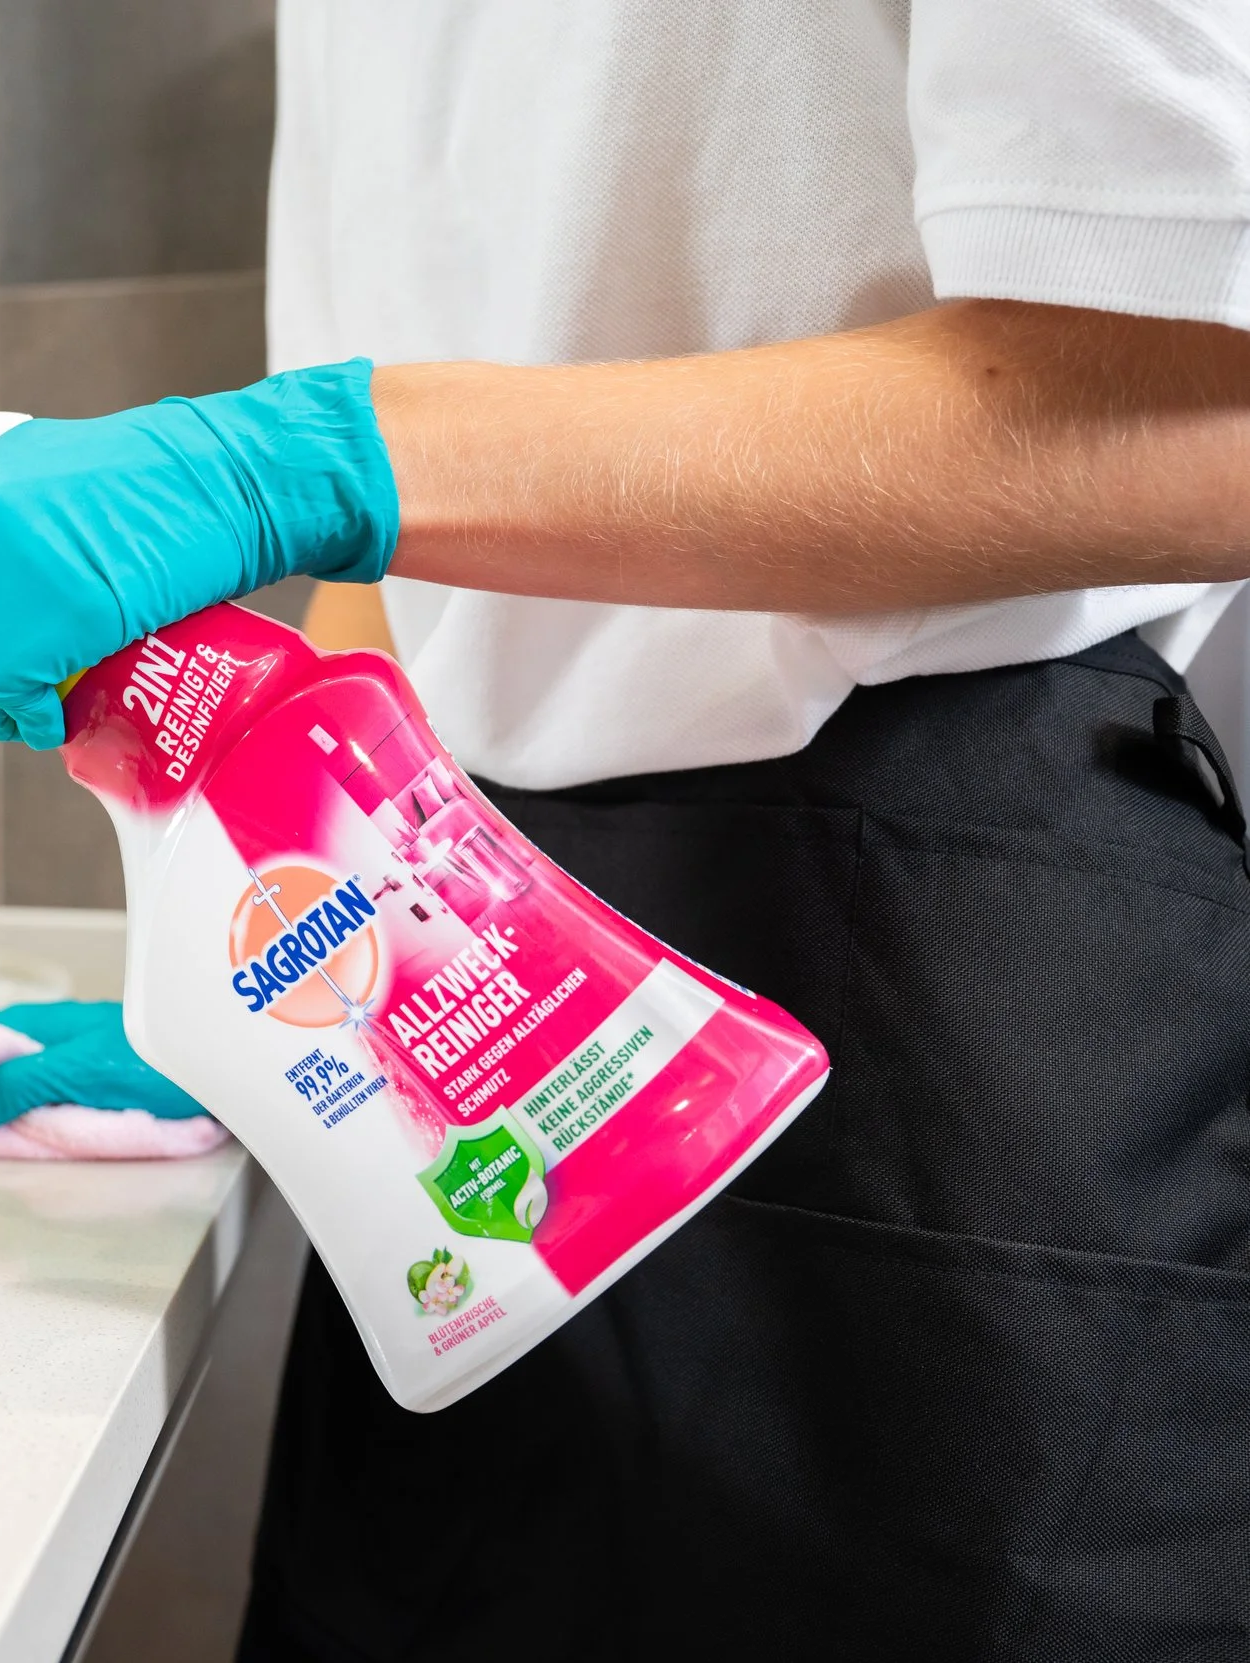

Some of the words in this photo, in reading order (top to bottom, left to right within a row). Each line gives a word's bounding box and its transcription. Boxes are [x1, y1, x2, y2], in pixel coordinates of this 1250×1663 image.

[122, 634, 187, 727] 2IN1
[155, 657, 209, 757] REINIGT
[196, 643, 218, 664] &
[166, 651, 240, 783] DESINFIZIERT
[232, 879, 377, 1013] SAGROTAN
[388, 922, 520, 1048] ALLZWECK-
[411, 971, 531, 1080] REINIGER
[443, 1062, 484, 1101] STARK
[478, 1034, 517, 1071] GEGEN
[511, 967, 588, 1042] ALLTÄGLICHEN
[285, 1048, 324, 1083] ENTFERNT
[295, 1055, 349, 1102] 99,9%
[312, 1100, 330, 1116] DER
[326, 1071, 365, 1106] BAKTERIEN
[322, 1119, 332, 1129] &
[328, 1090, 368, 1125] BEHÜLLTEN
[365, 1074, 389, 1096] VIREN
[457, 1068, 512, 1118] SCHMUTZ
[523, 1040, 606, 1118] HINTERLÄSST
[537, 1096, 579, 1136] KEINE
[576, 1025, 654, 1104] AGGRESSIVEN
[450, 1145, 521, 1209] ACTIV-BOTANIC
[428, 1295, 498, 1345] BLÜTENFRISCHE
[433, 1346, 443, 1356] &
[442, 1324, 478, 1352] GRÜNER
[478, 1307, 507, 1330] APFEL
